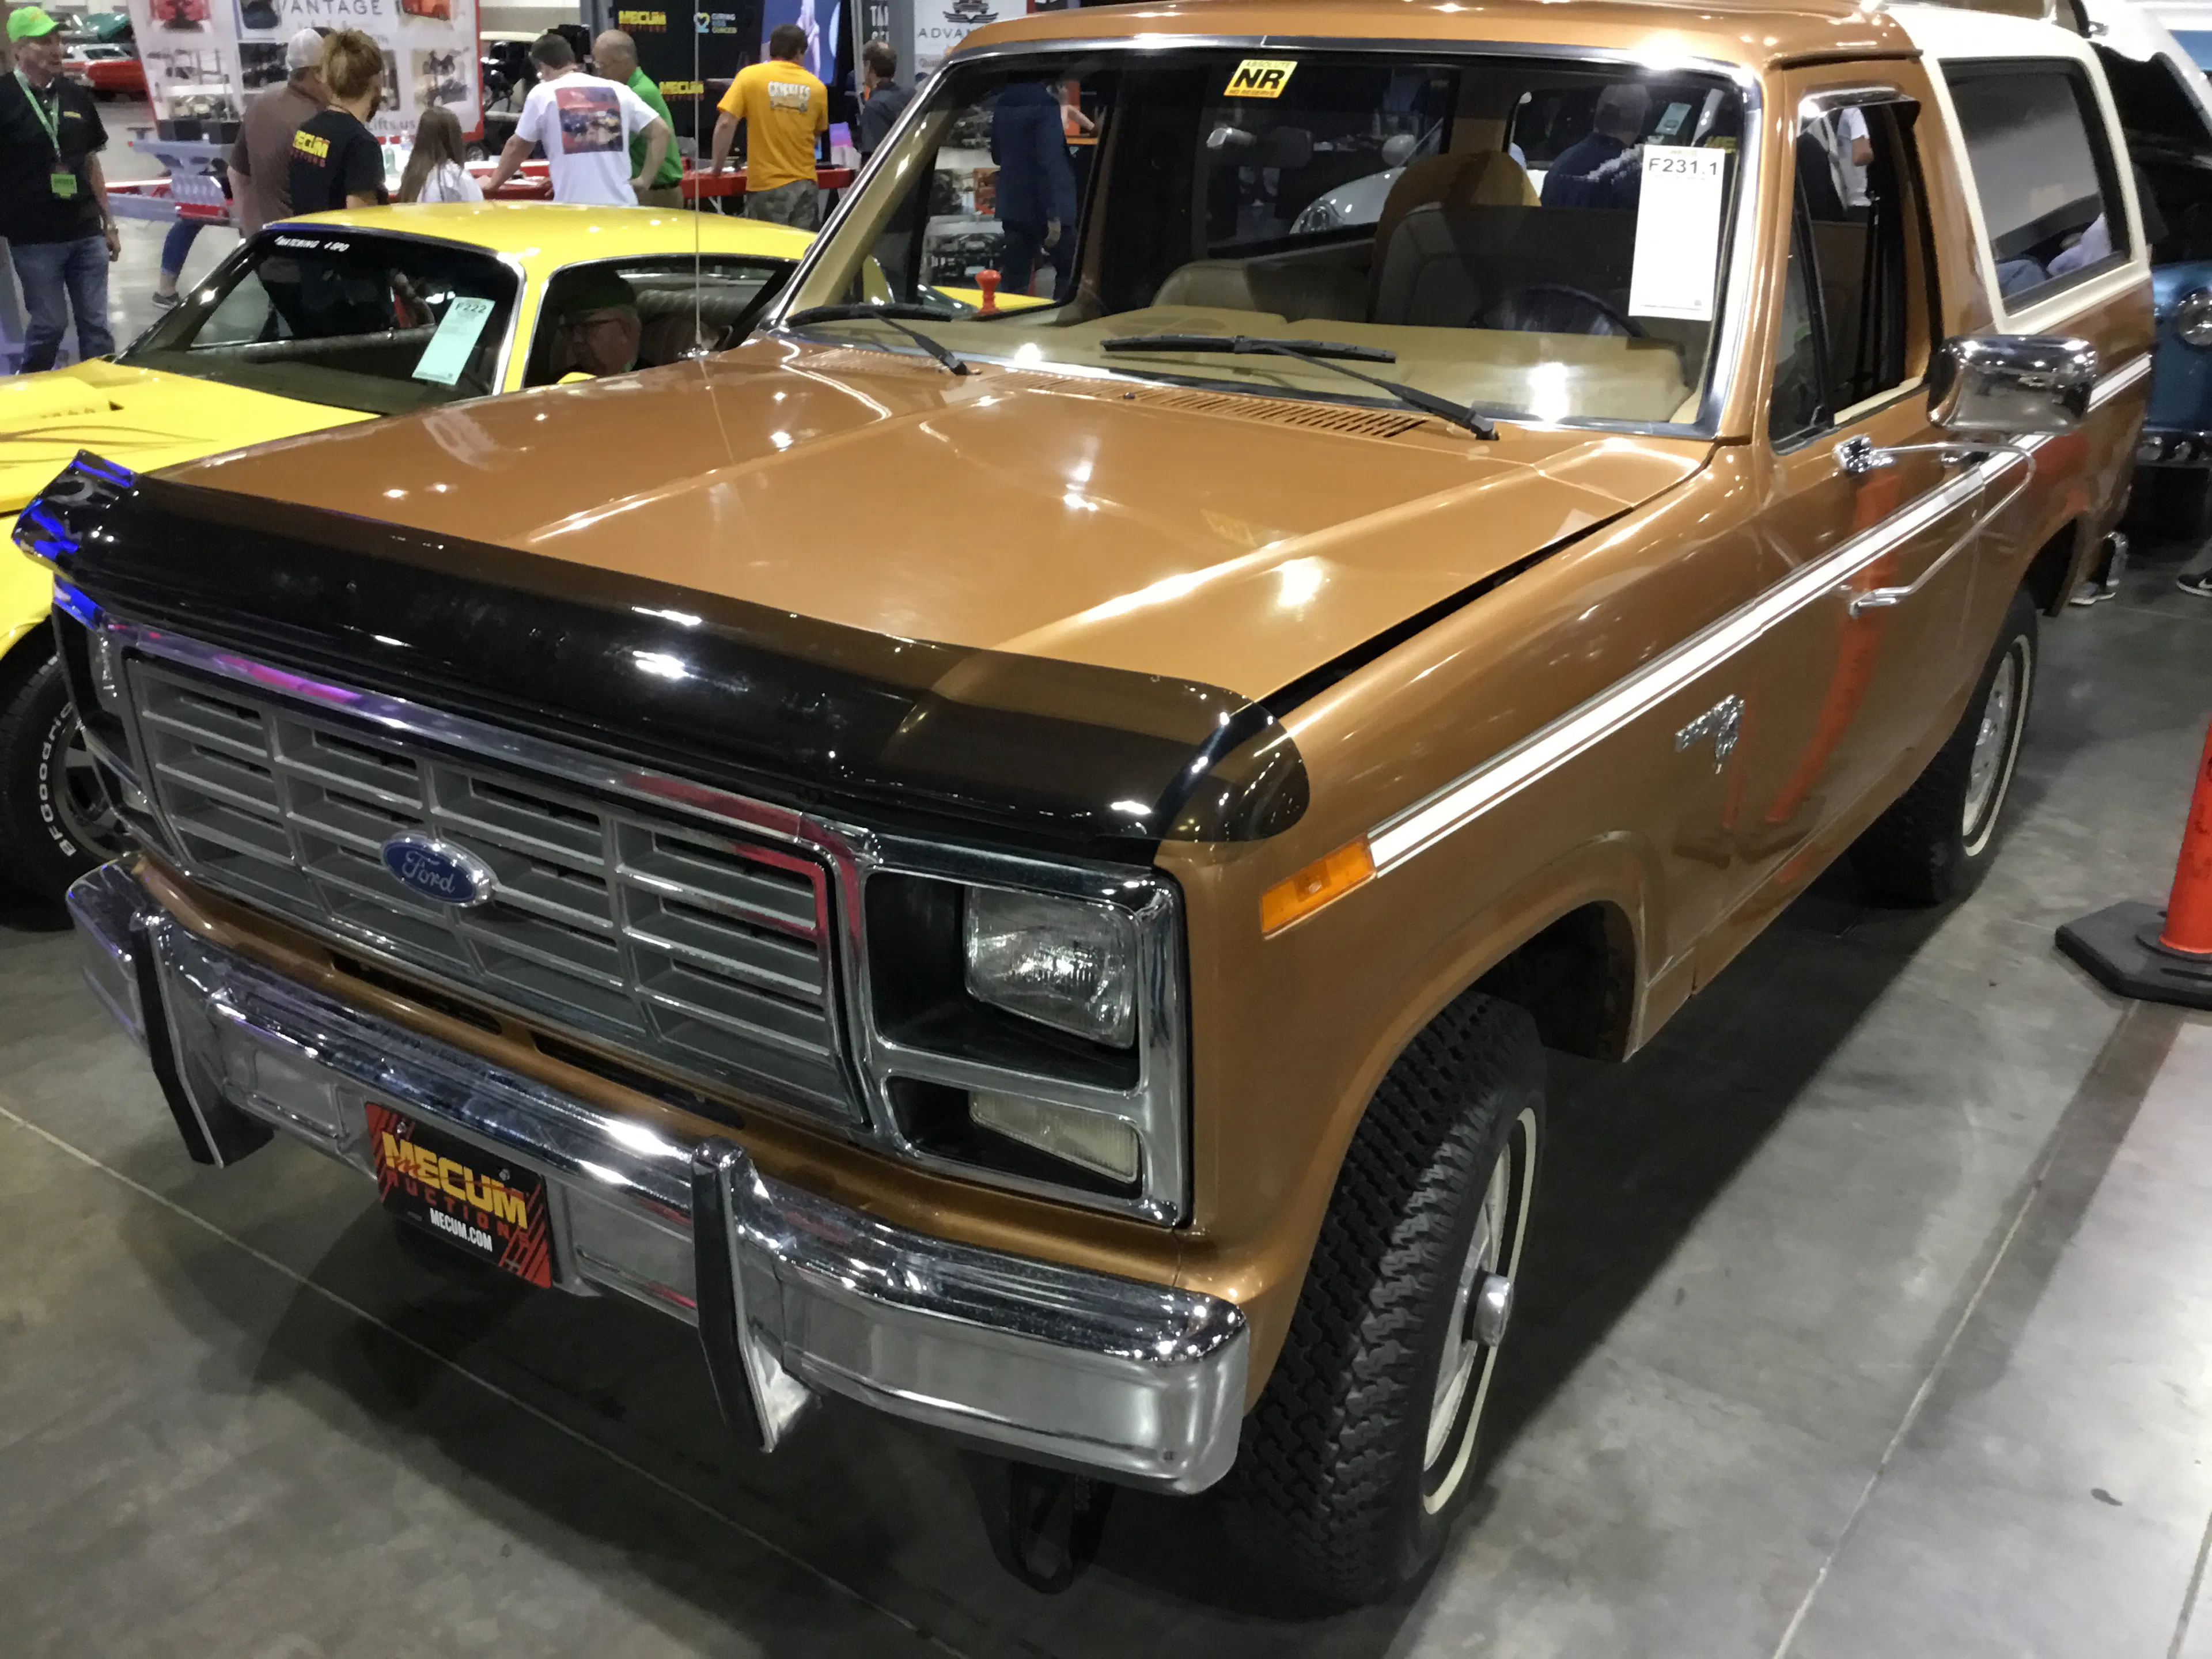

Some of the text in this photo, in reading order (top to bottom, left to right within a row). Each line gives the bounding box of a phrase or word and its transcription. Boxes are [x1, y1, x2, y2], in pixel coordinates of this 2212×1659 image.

[618, 10, 666, 25] MECUM
[659, 81, 704, 94] MECUM
[1233, 68, 1285, 89] NR
[1649, 158, 1717, 176] F231.1
[454, 302, 487, 314] F222
[402, 851, 456, 893] Ford
[382, 1131, 528, 1229] MECUM
[430, 1207, 493, 1253] MECUM.COM
